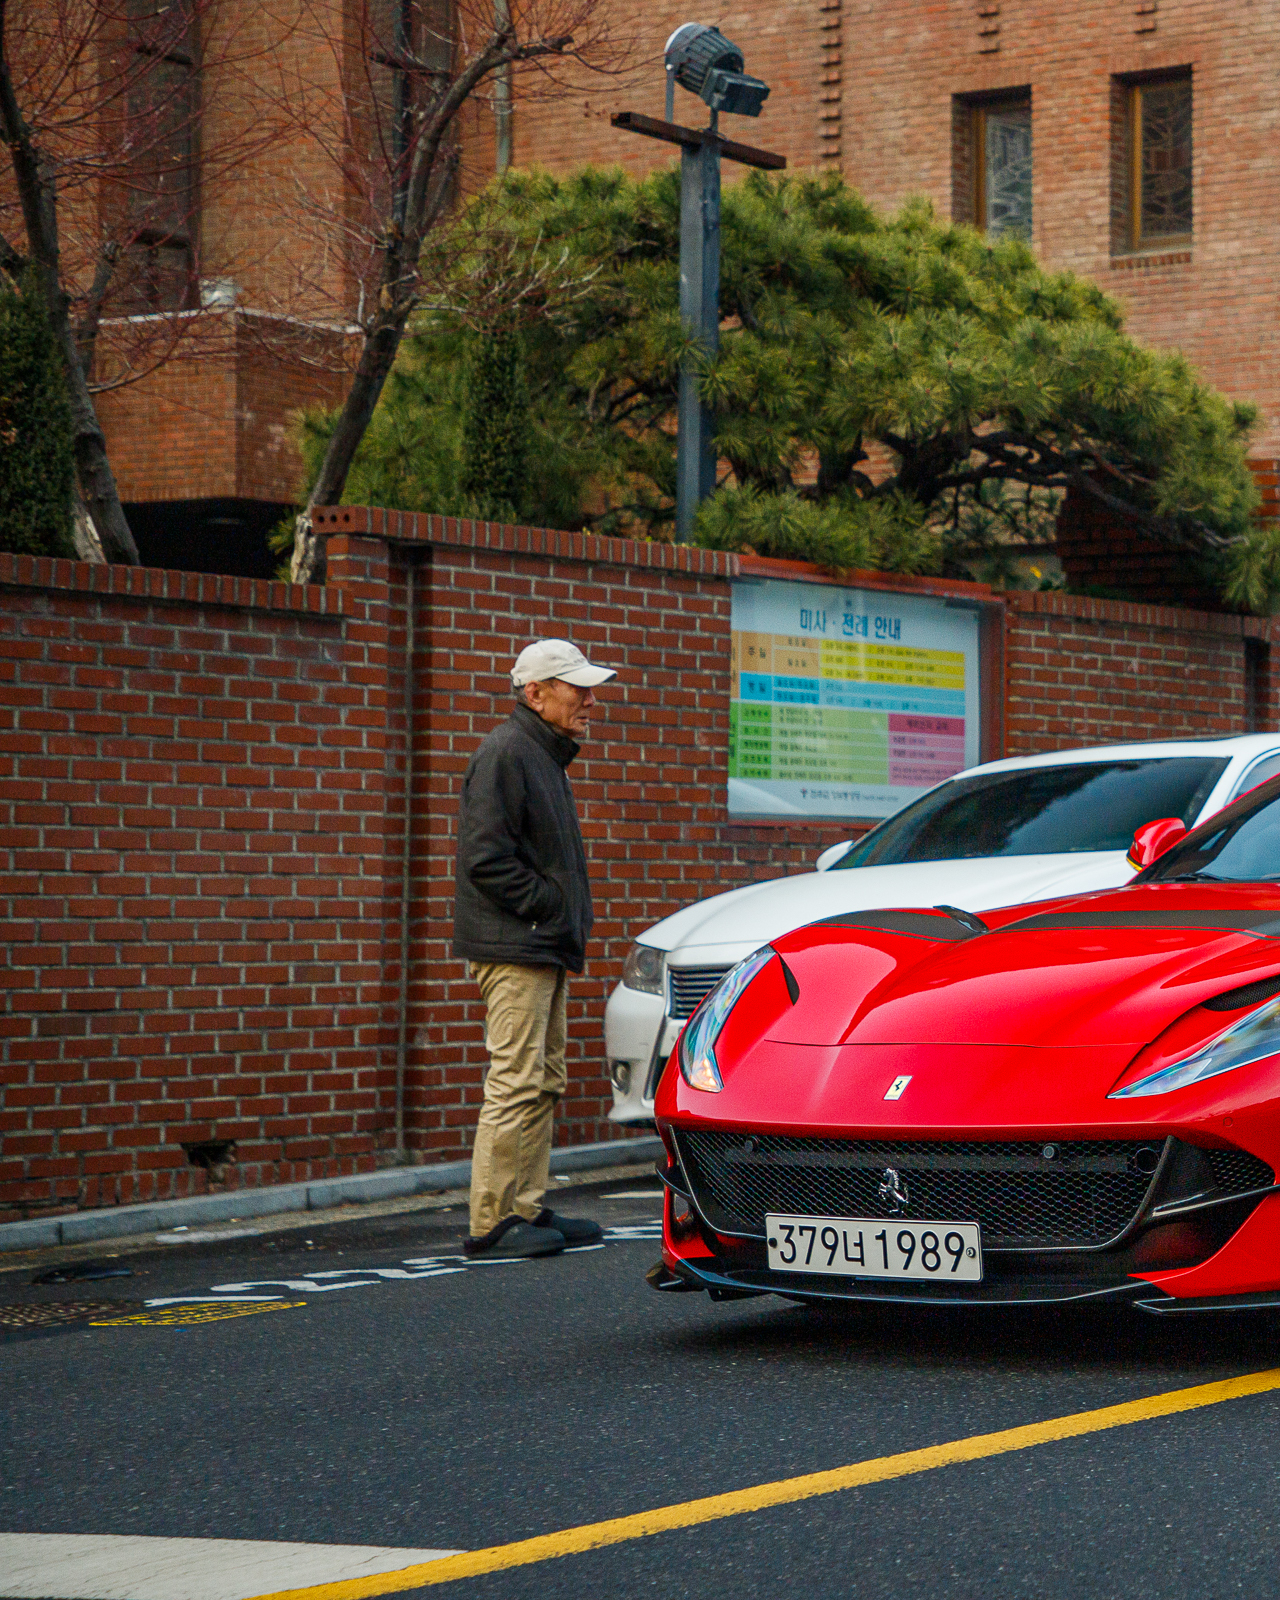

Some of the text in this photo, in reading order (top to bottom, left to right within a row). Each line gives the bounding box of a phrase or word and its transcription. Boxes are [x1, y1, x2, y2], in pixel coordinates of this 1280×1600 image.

[799, 608, 901, 641] 미사 전례 안내
[778, 1223, 965, 1273] 379너 1989
